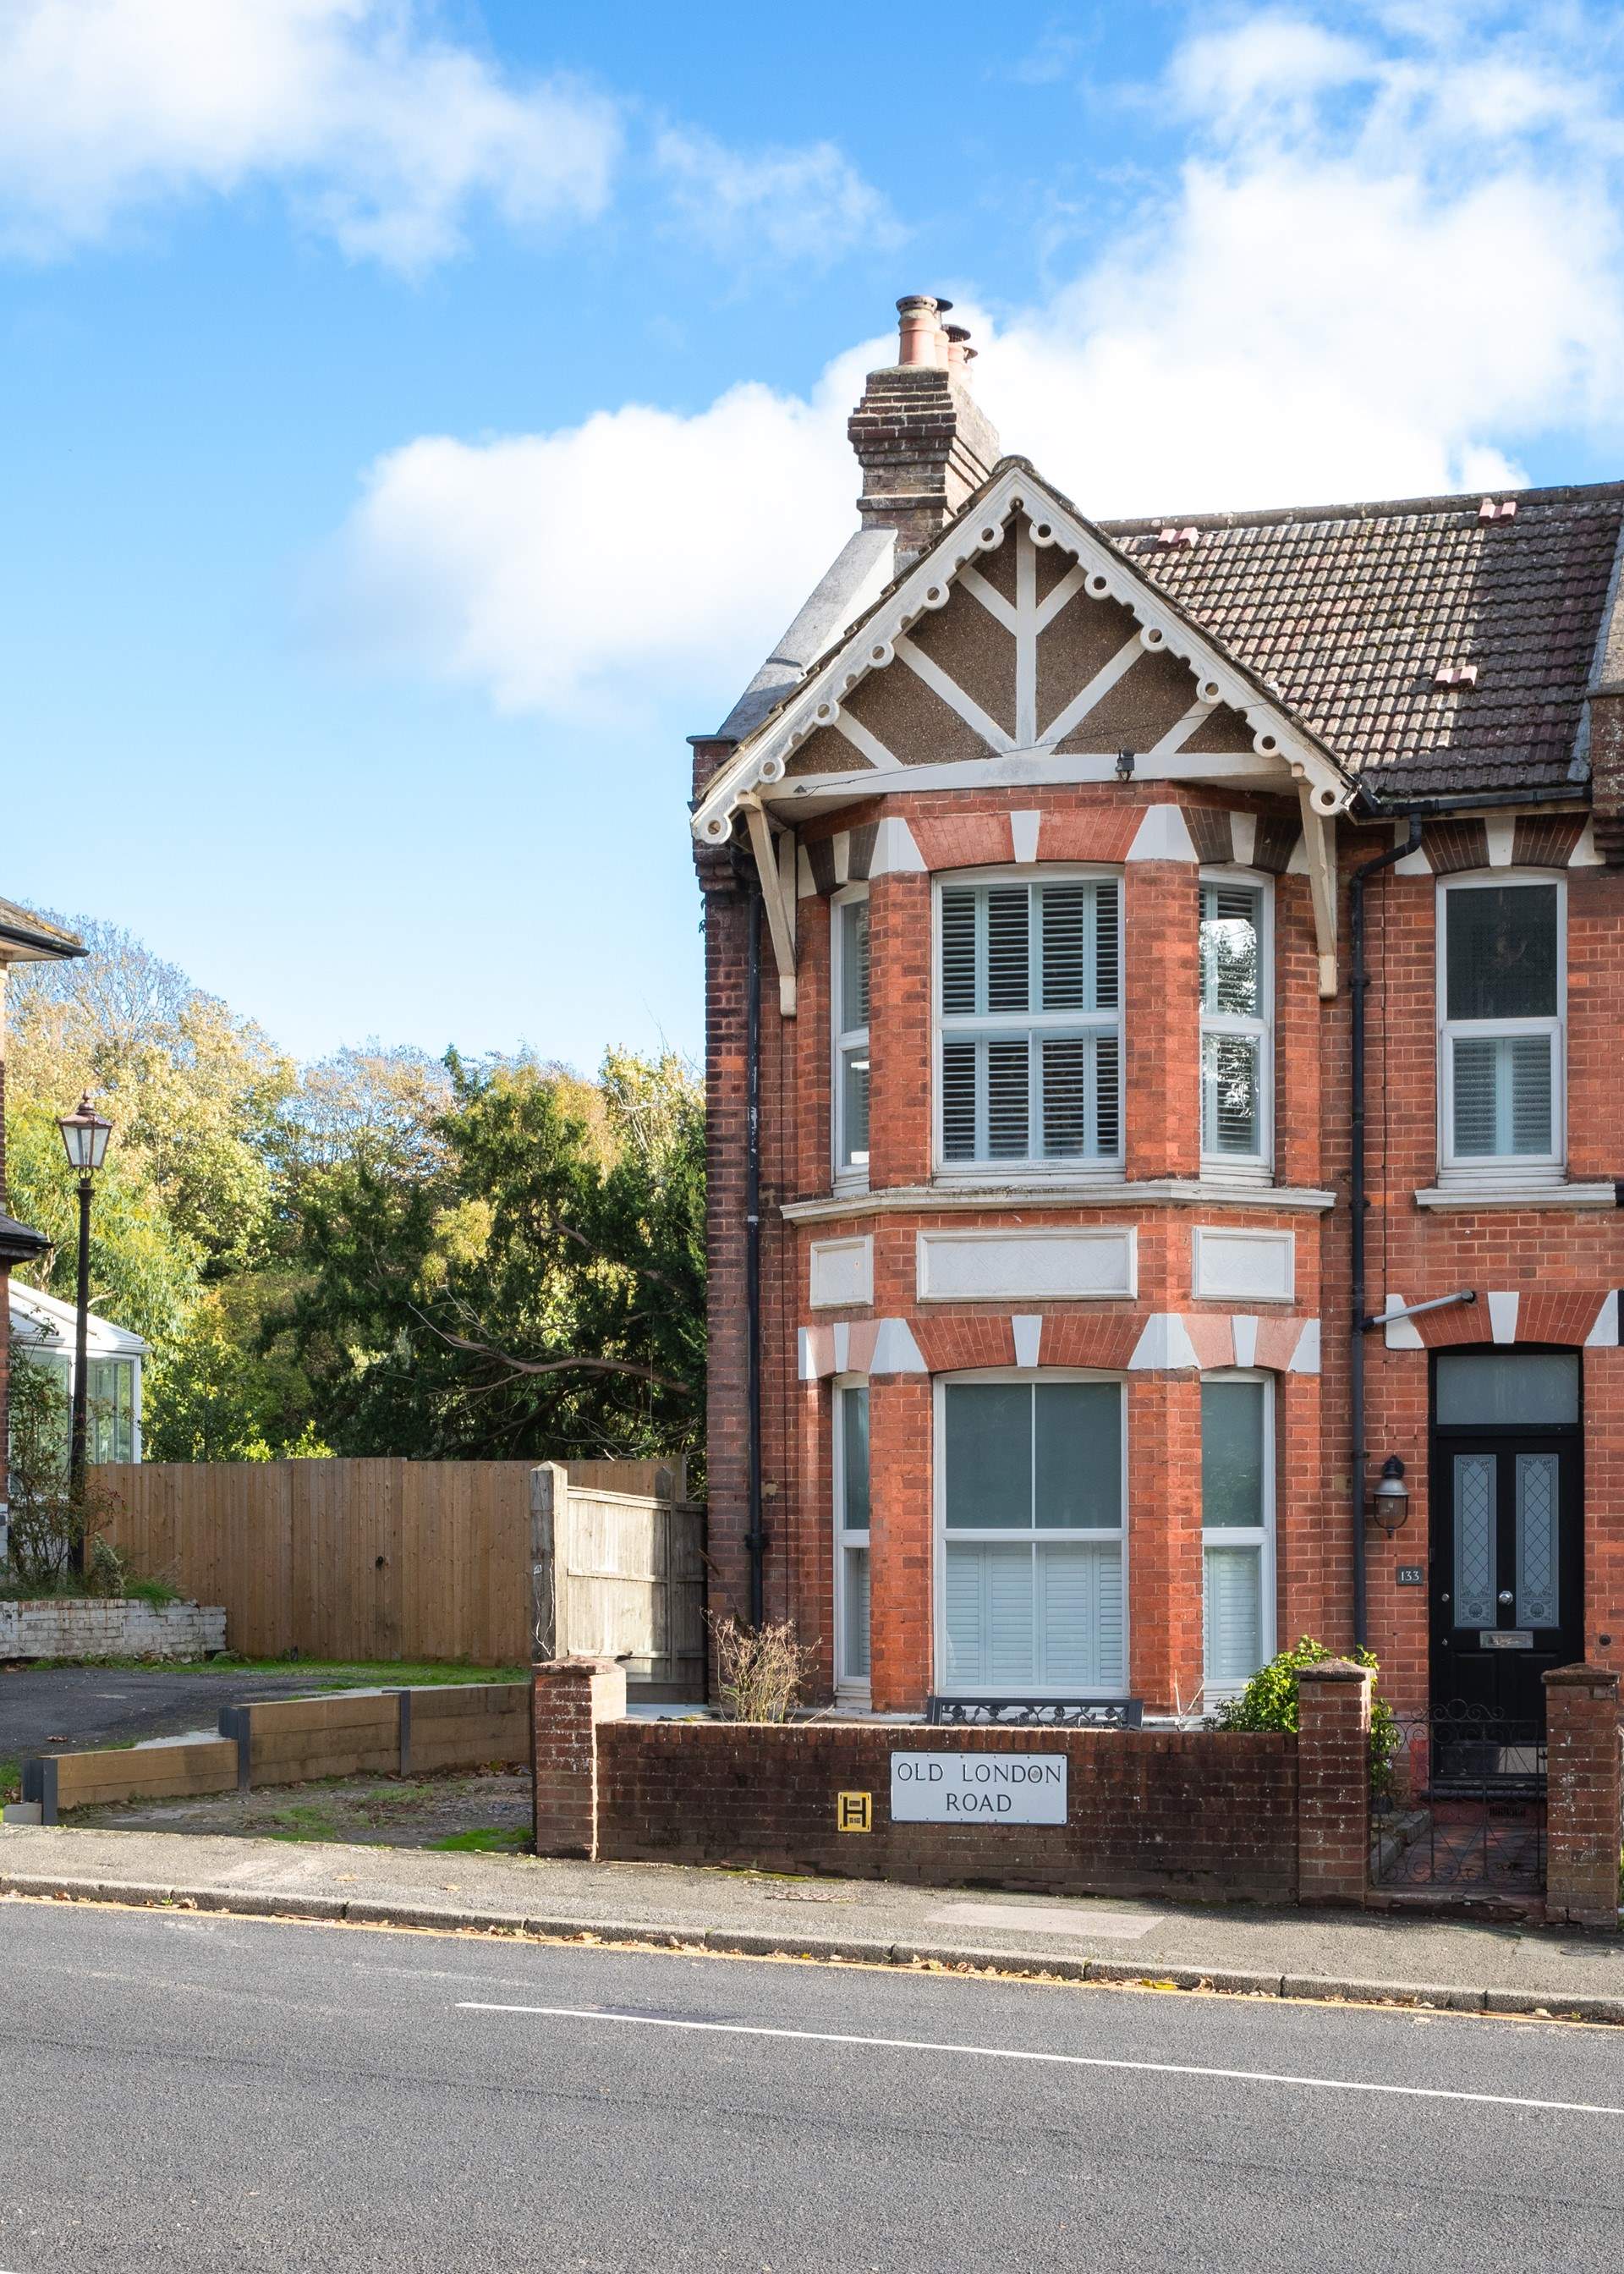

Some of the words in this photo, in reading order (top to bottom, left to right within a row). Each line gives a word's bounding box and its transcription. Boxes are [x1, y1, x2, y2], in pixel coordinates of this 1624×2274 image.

[1401, 1570, 1420, 1581] 133
[897, 1762, 944, 1782] OLD
[963, 1764, 1062, 1783] LONDON
[842, 1796, 867, 1828] H
[946, 1793, 1012, 1812] ROAD
